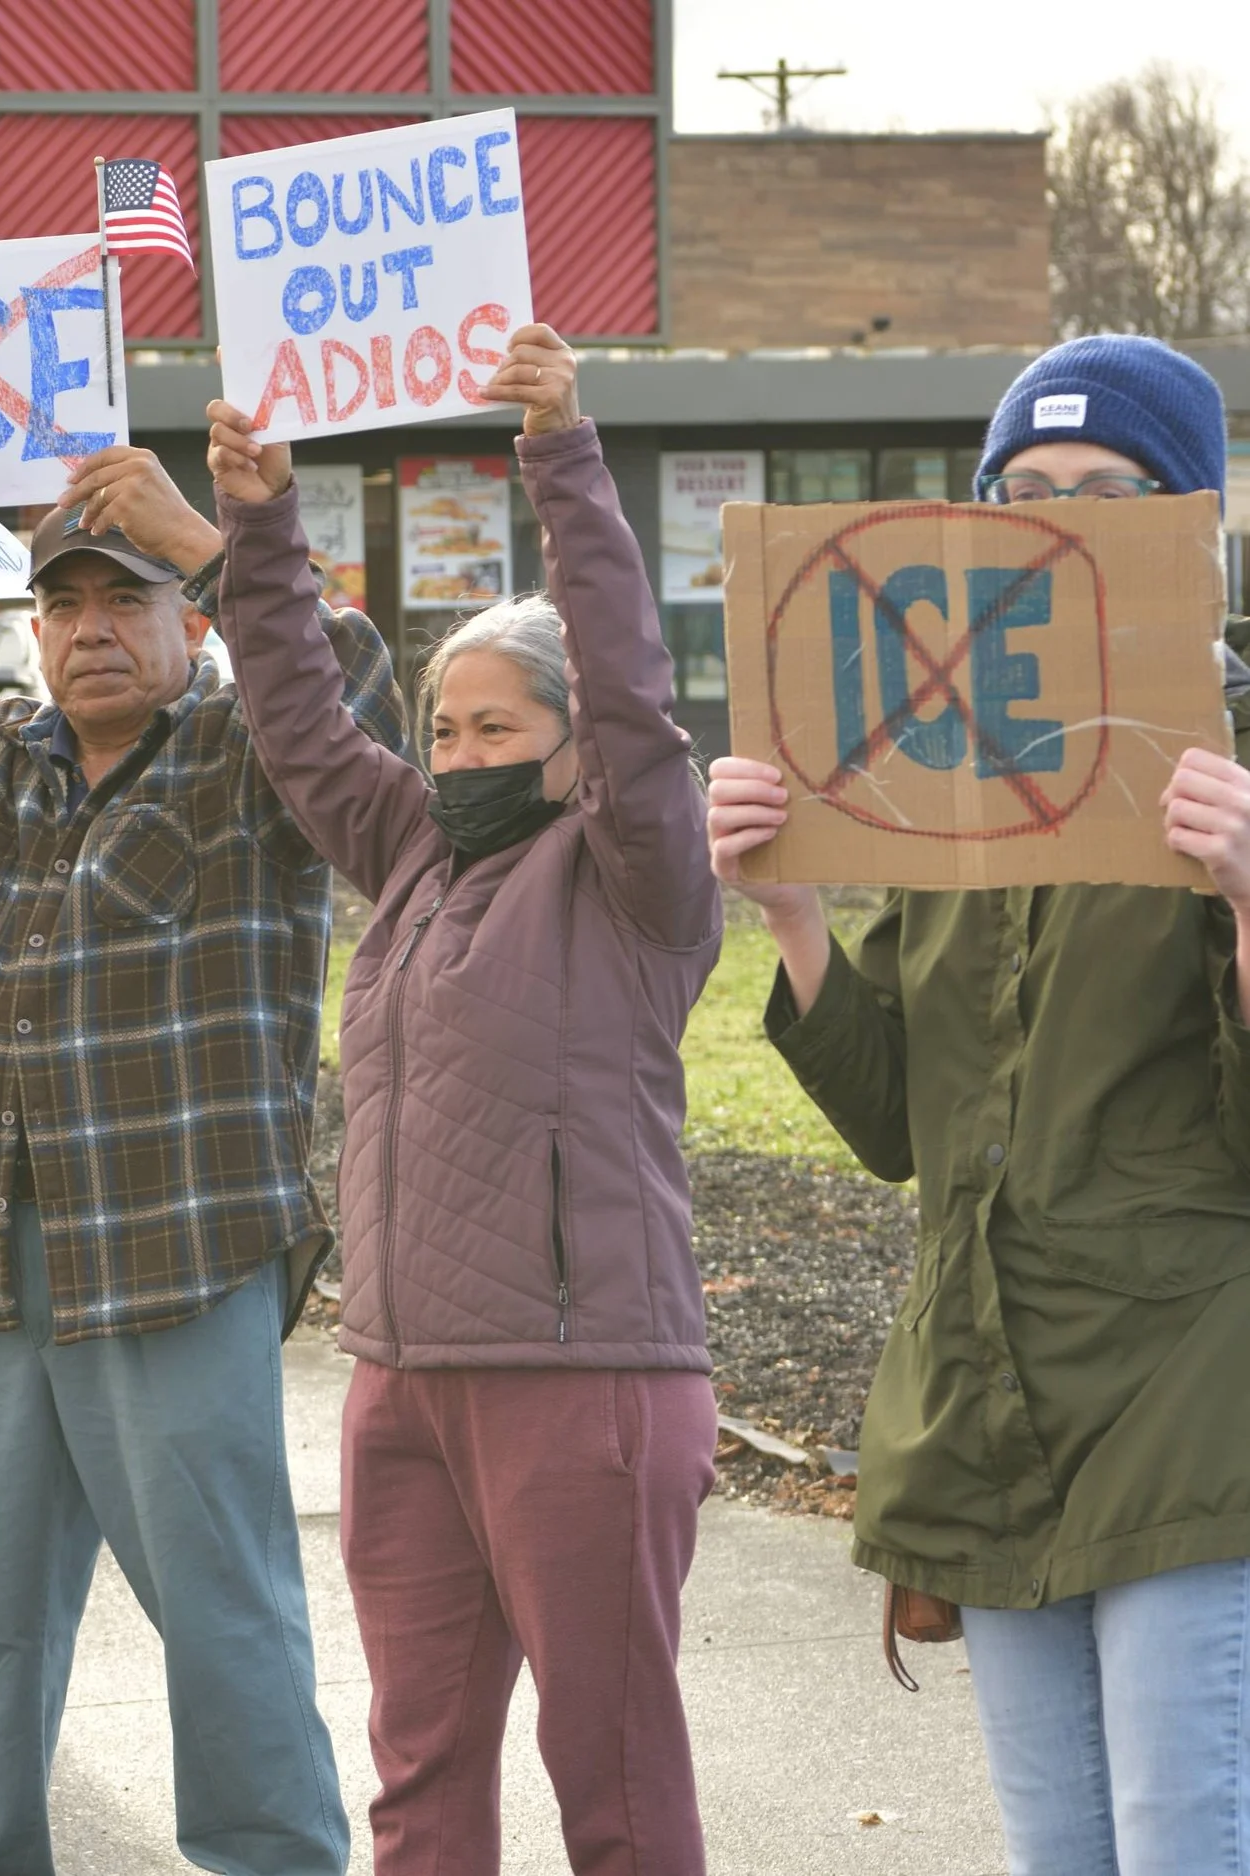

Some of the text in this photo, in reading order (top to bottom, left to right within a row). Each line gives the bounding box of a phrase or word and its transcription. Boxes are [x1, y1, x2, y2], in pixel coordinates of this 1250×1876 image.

[232, 130, 520, 260] BOUNCE
[281, 244, 433, 335] OUT
[252, 303, 512, 432] ADIOS
[675, 475, 745, 493] DESSERT
[828, 564, 1066, 780] ICE
